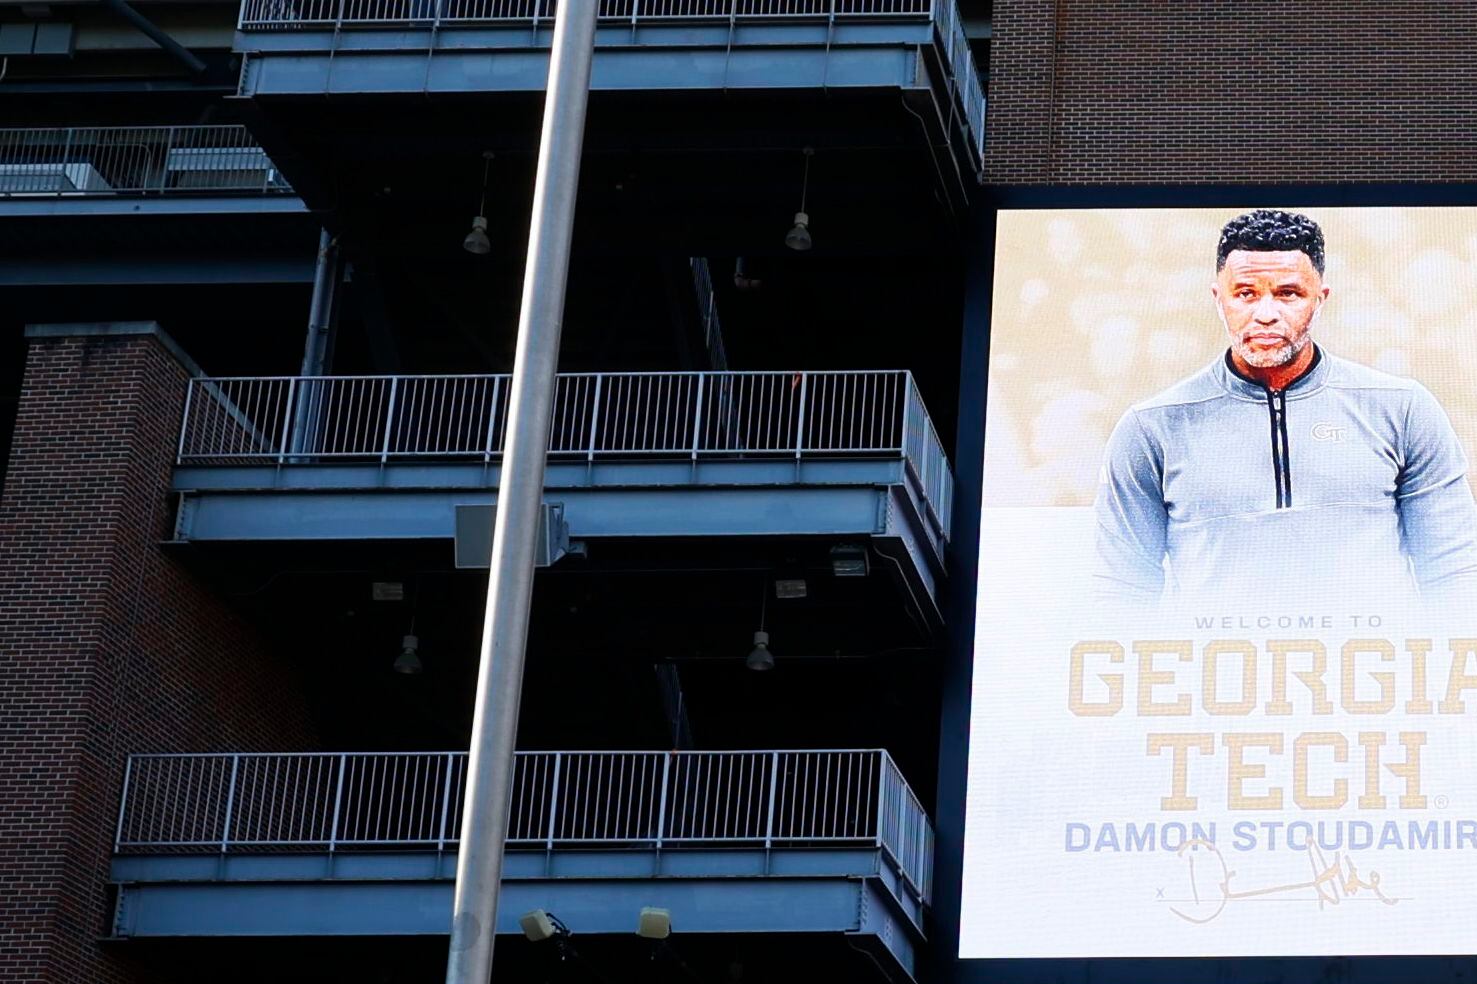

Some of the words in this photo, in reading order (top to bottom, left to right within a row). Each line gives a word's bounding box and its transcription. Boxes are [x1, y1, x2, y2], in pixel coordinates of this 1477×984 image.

[1194, 615, 1334, 630] WELCOME
[1349, 615, 1382, 629] TO
[1146, 731, 1428, 811] TECH
[1064, 821, 1217, 853] DAMON
